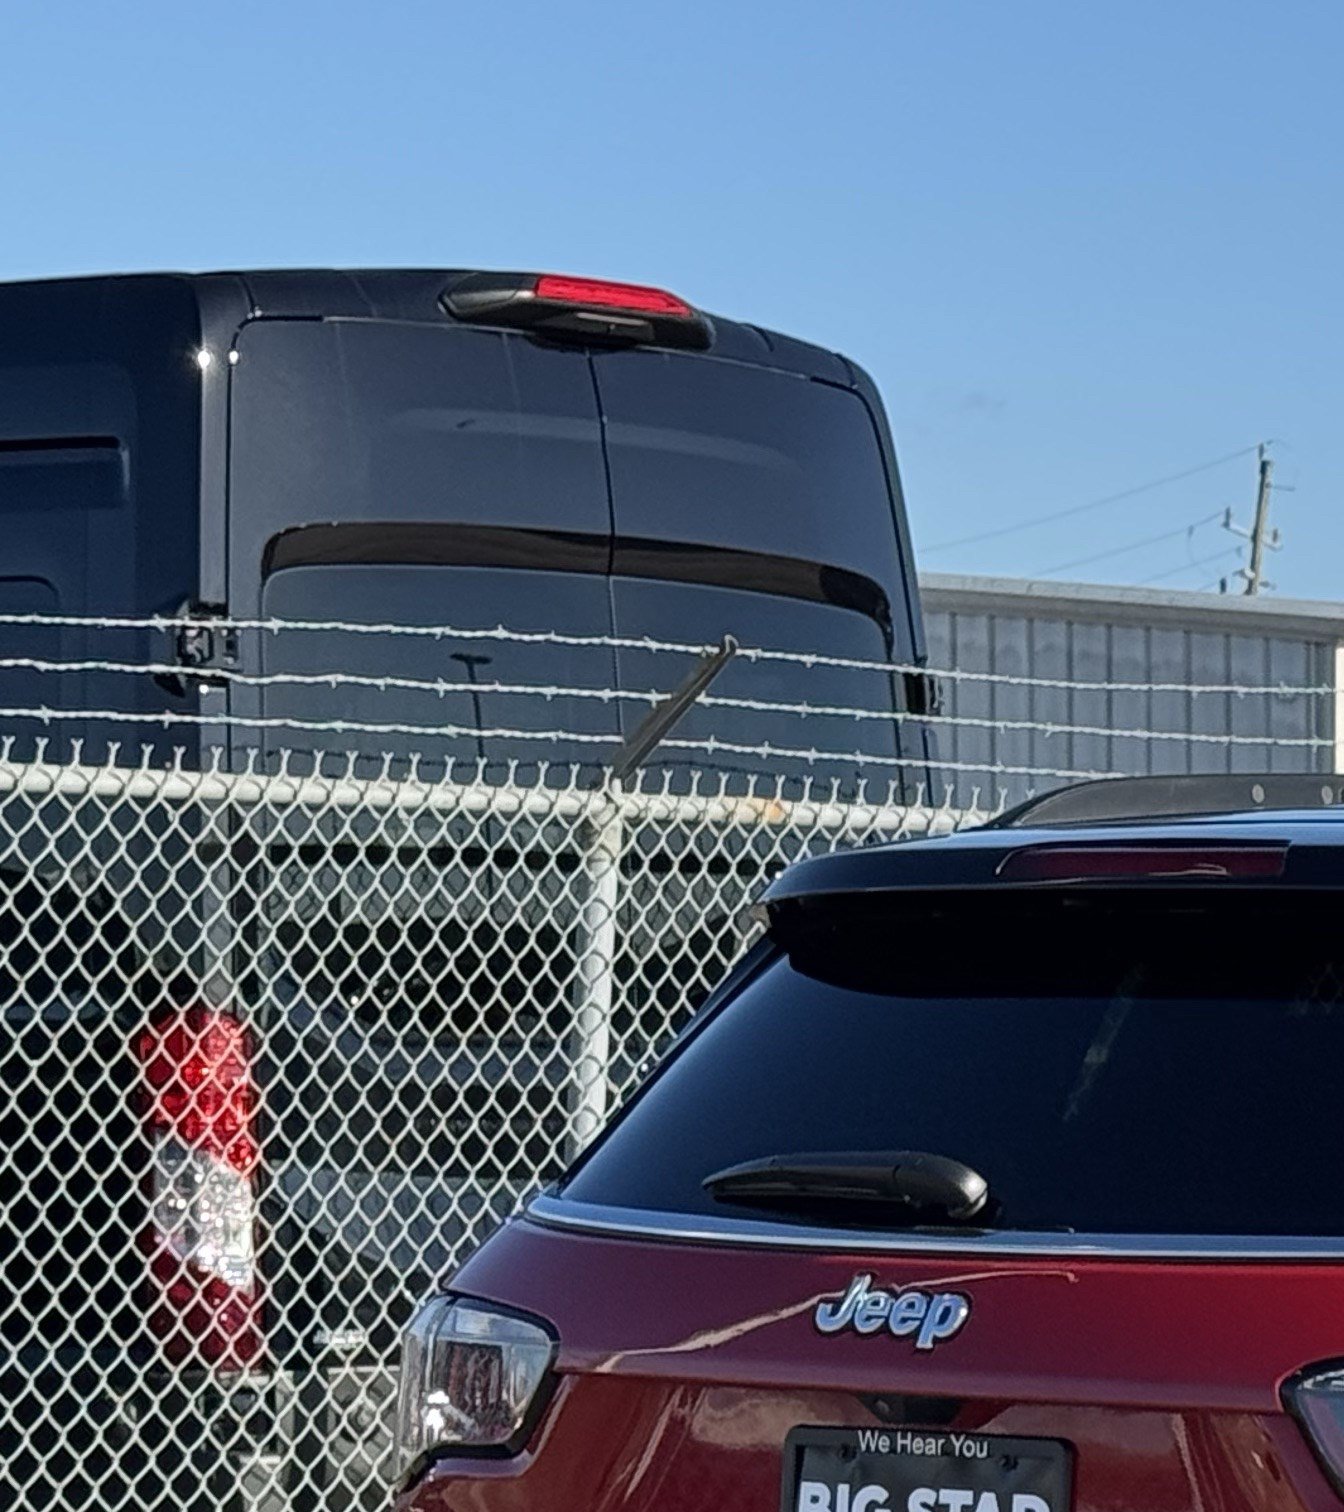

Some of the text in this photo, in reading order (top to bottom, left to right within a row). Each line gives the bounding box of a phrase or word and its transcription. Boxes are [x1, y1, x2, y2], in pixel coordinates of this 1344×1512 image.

[815, 1273, 970, 1350] Jeep
[857, 1430, 988, 1459] We Hear You
